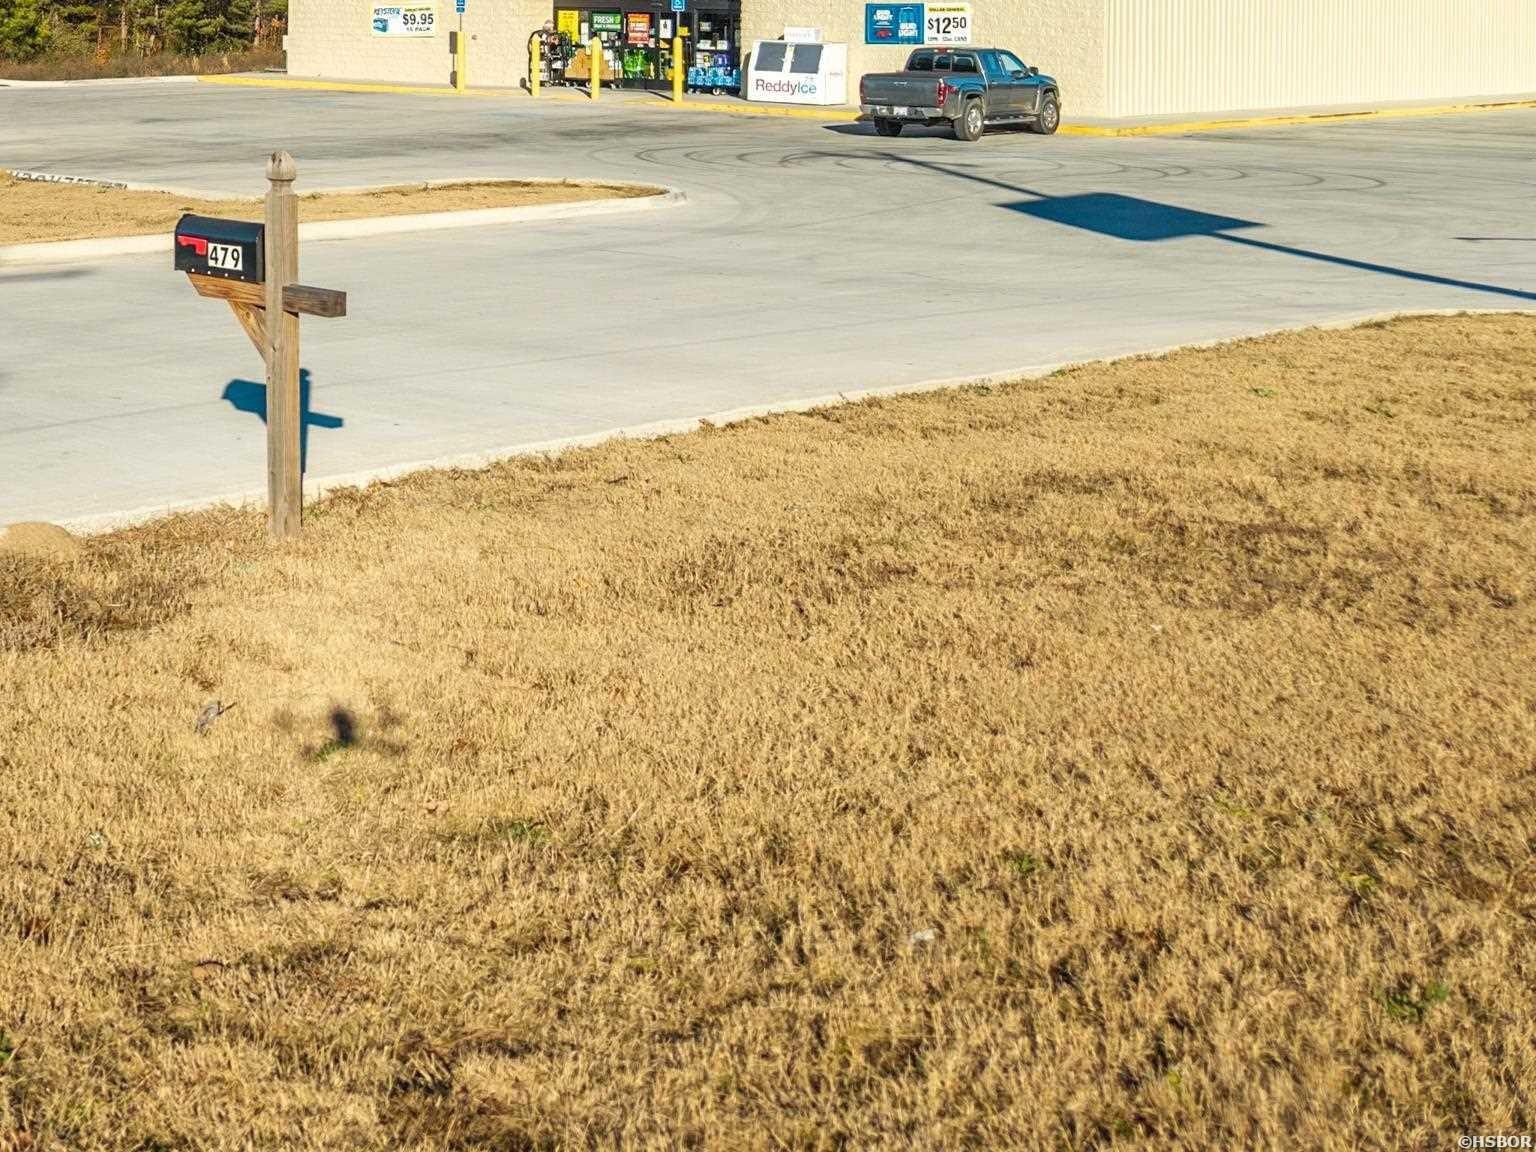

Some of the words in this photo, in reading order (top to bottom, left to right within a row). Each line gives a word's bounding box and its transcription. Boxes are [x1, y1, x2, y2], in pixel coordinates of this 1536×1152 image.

[402, 13, 434, 25] $9.95
[592, 15, 615, 25] FRESH
[209, 245, 240, 268] 479
